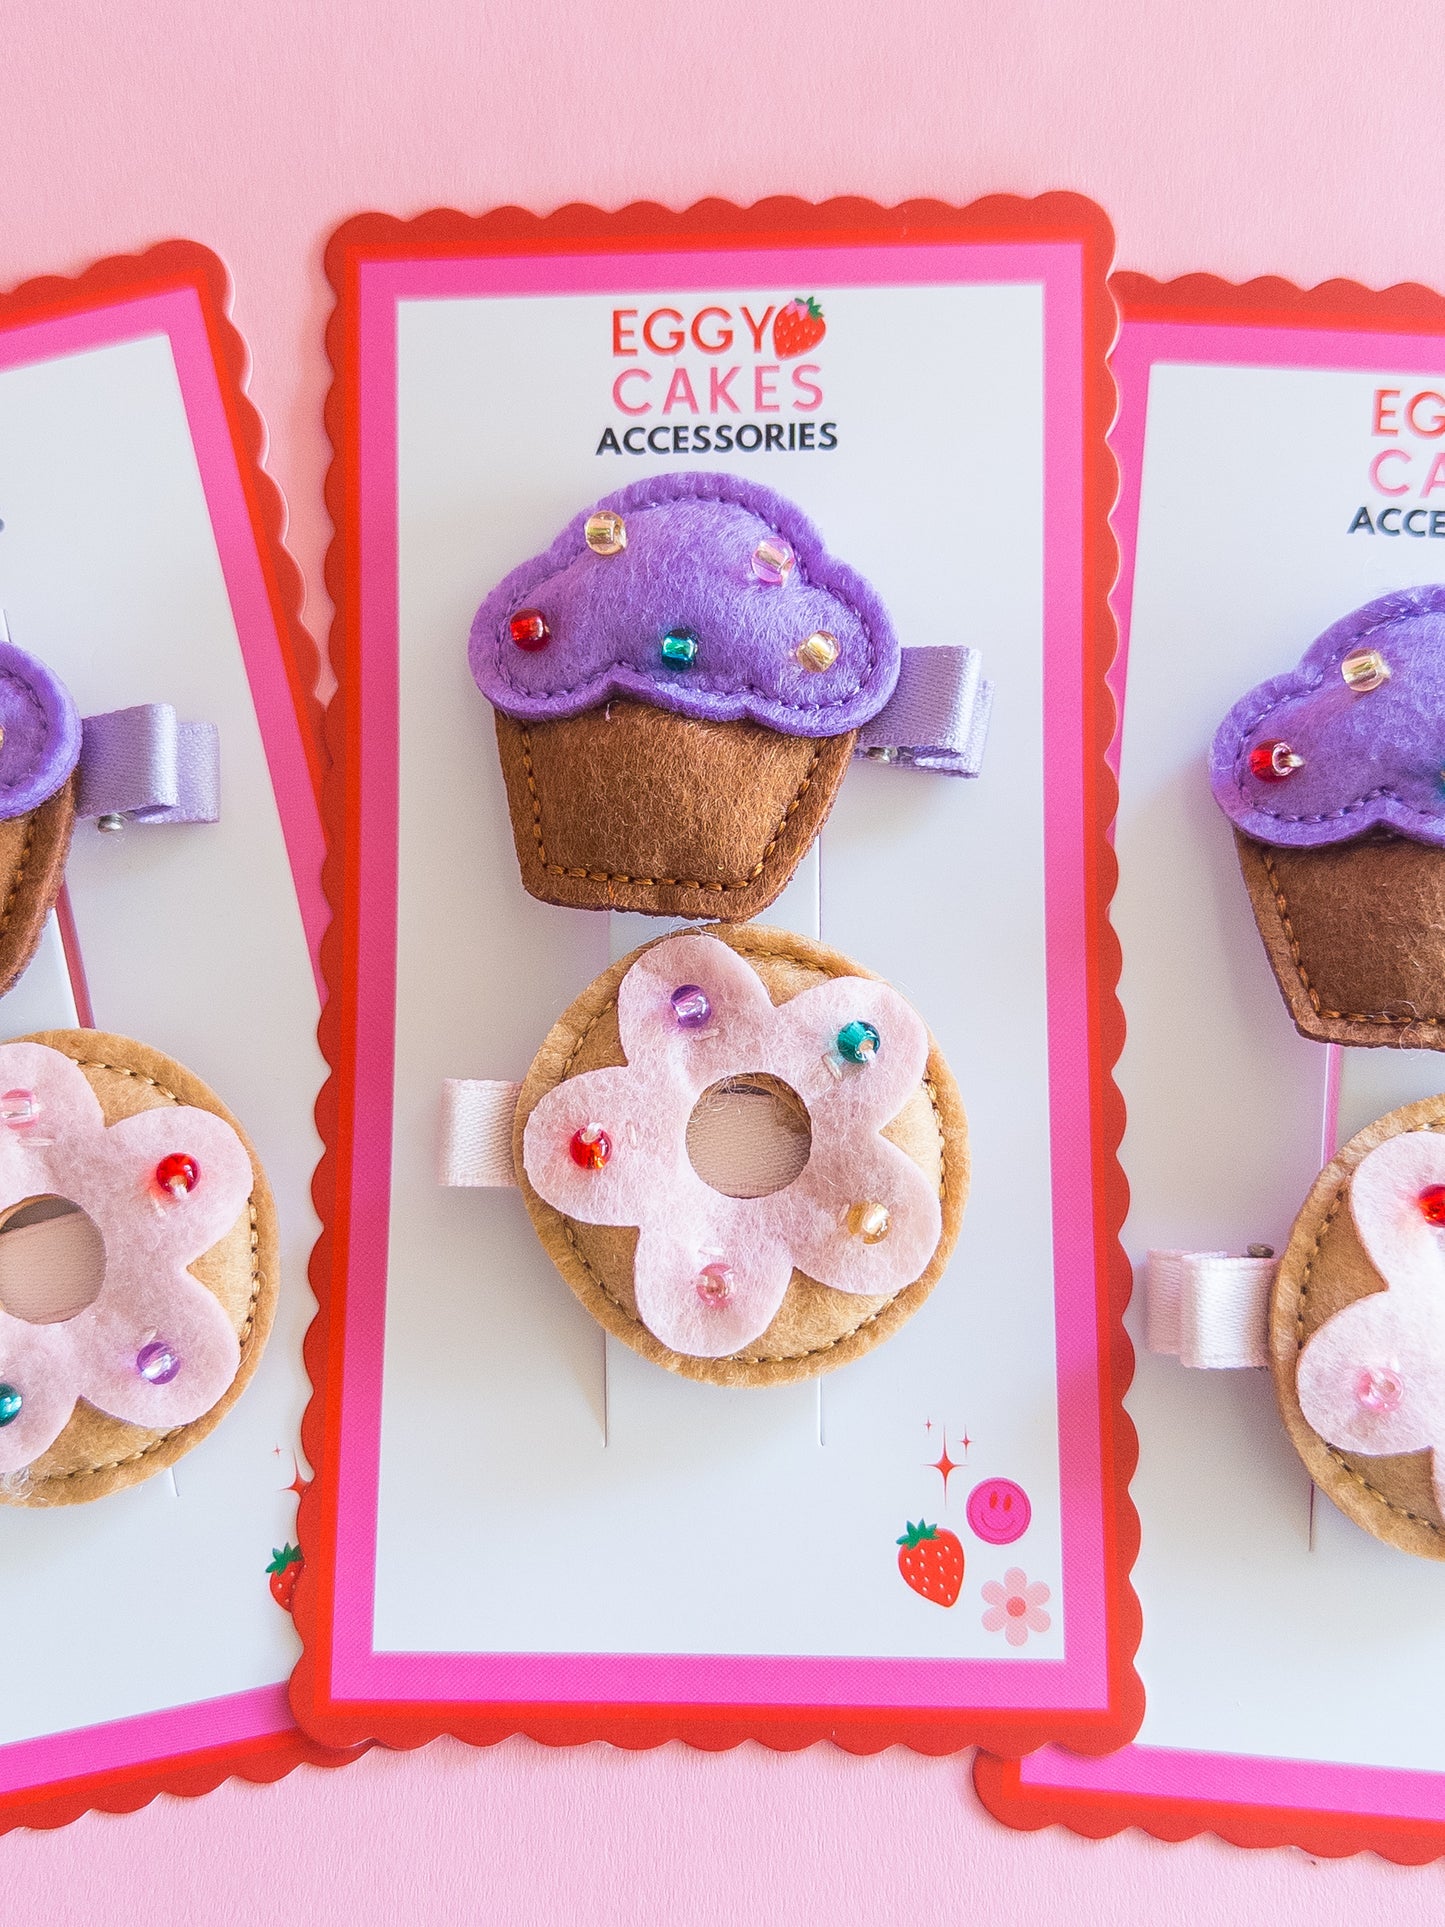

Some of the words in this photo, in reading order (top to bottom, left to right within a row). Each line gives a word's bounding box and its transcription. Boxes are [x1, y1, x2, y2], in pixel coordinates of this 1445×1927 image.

[612, 305, 776, 357] EGGY
[612, 363, 824, 417] CAKES
[595, 422, 838, 456] ACCESSORIES
